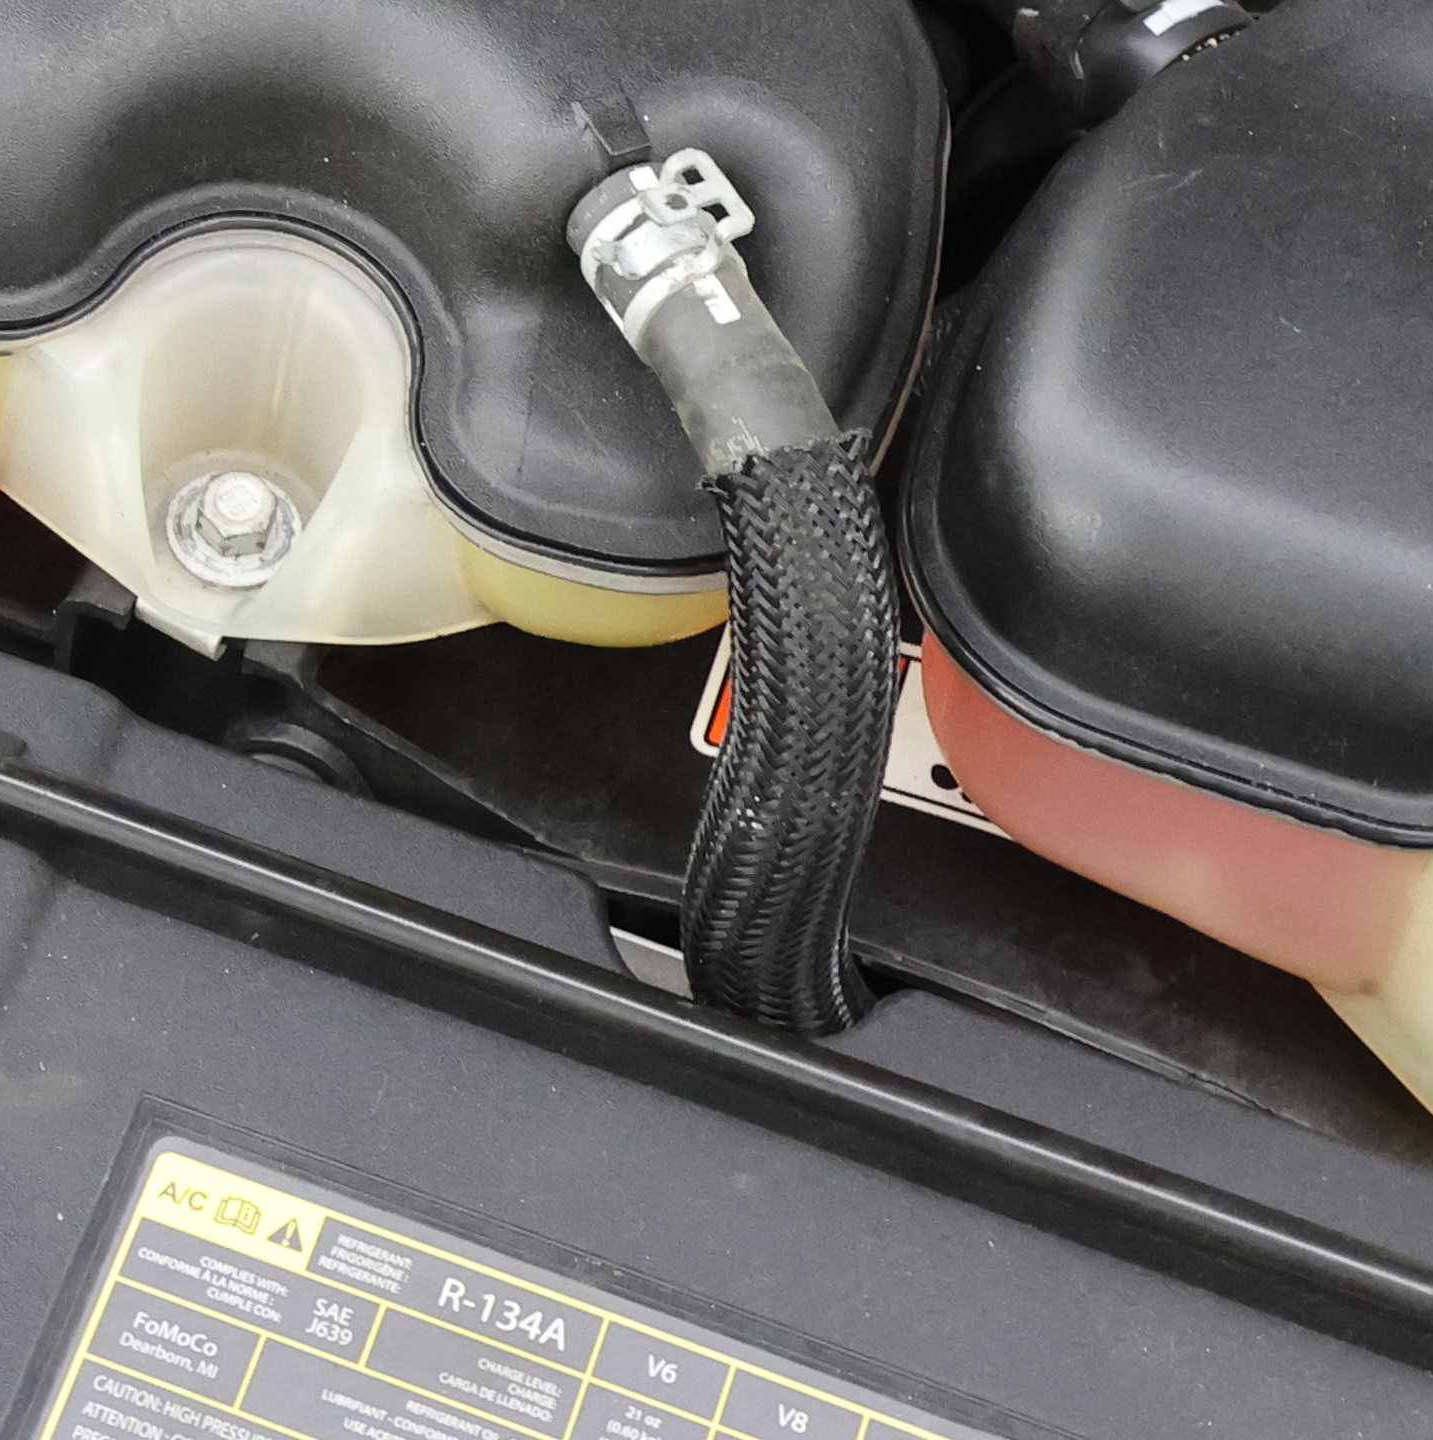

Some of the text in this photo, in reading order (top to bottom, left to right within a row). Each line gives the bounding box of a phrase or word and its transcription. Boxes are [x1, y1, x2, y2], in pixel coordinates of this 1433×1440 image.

[158, 1181, 208, 1211] A/C
[137, 1247, 201, 1279] CONFORME
[211, 1274, 228, 1288] LA
[199, 1256, 290, 1298] COMPLIES WITH:
[206, 1287, 253, 1314] CUMPLE
[313, 1298, 354, 1327] SAE
[437, 1277, 566, 1352] R-134A
[133, 1311, 218, 1357] FoMoCo
[304, 1317, 353, 1346] J639
[119, 1331, 219, 1380] Dearborn, MI
[647, 1354, 678, 1384] V6
[477, 1357, 563, 1397] CHARGE LEVEL:
[93, 1374, 163, 1413] CAUTION:
[162, 1400, 202, 1427] HIGH
[321, 1389, 388, 1421] LUBRIFIANT
[439, 1372, 554, 1423] CARGA DE LLENADO:
[508, 1383, 558, 1410] CHARGE:
[343, 1417, 368, 1436] USE
[405, 1399, 483, 1438] REFRIGERANT
[624, 1405, 663, 1429] 21 oz
[777, 1404, 809, 1433] V8
